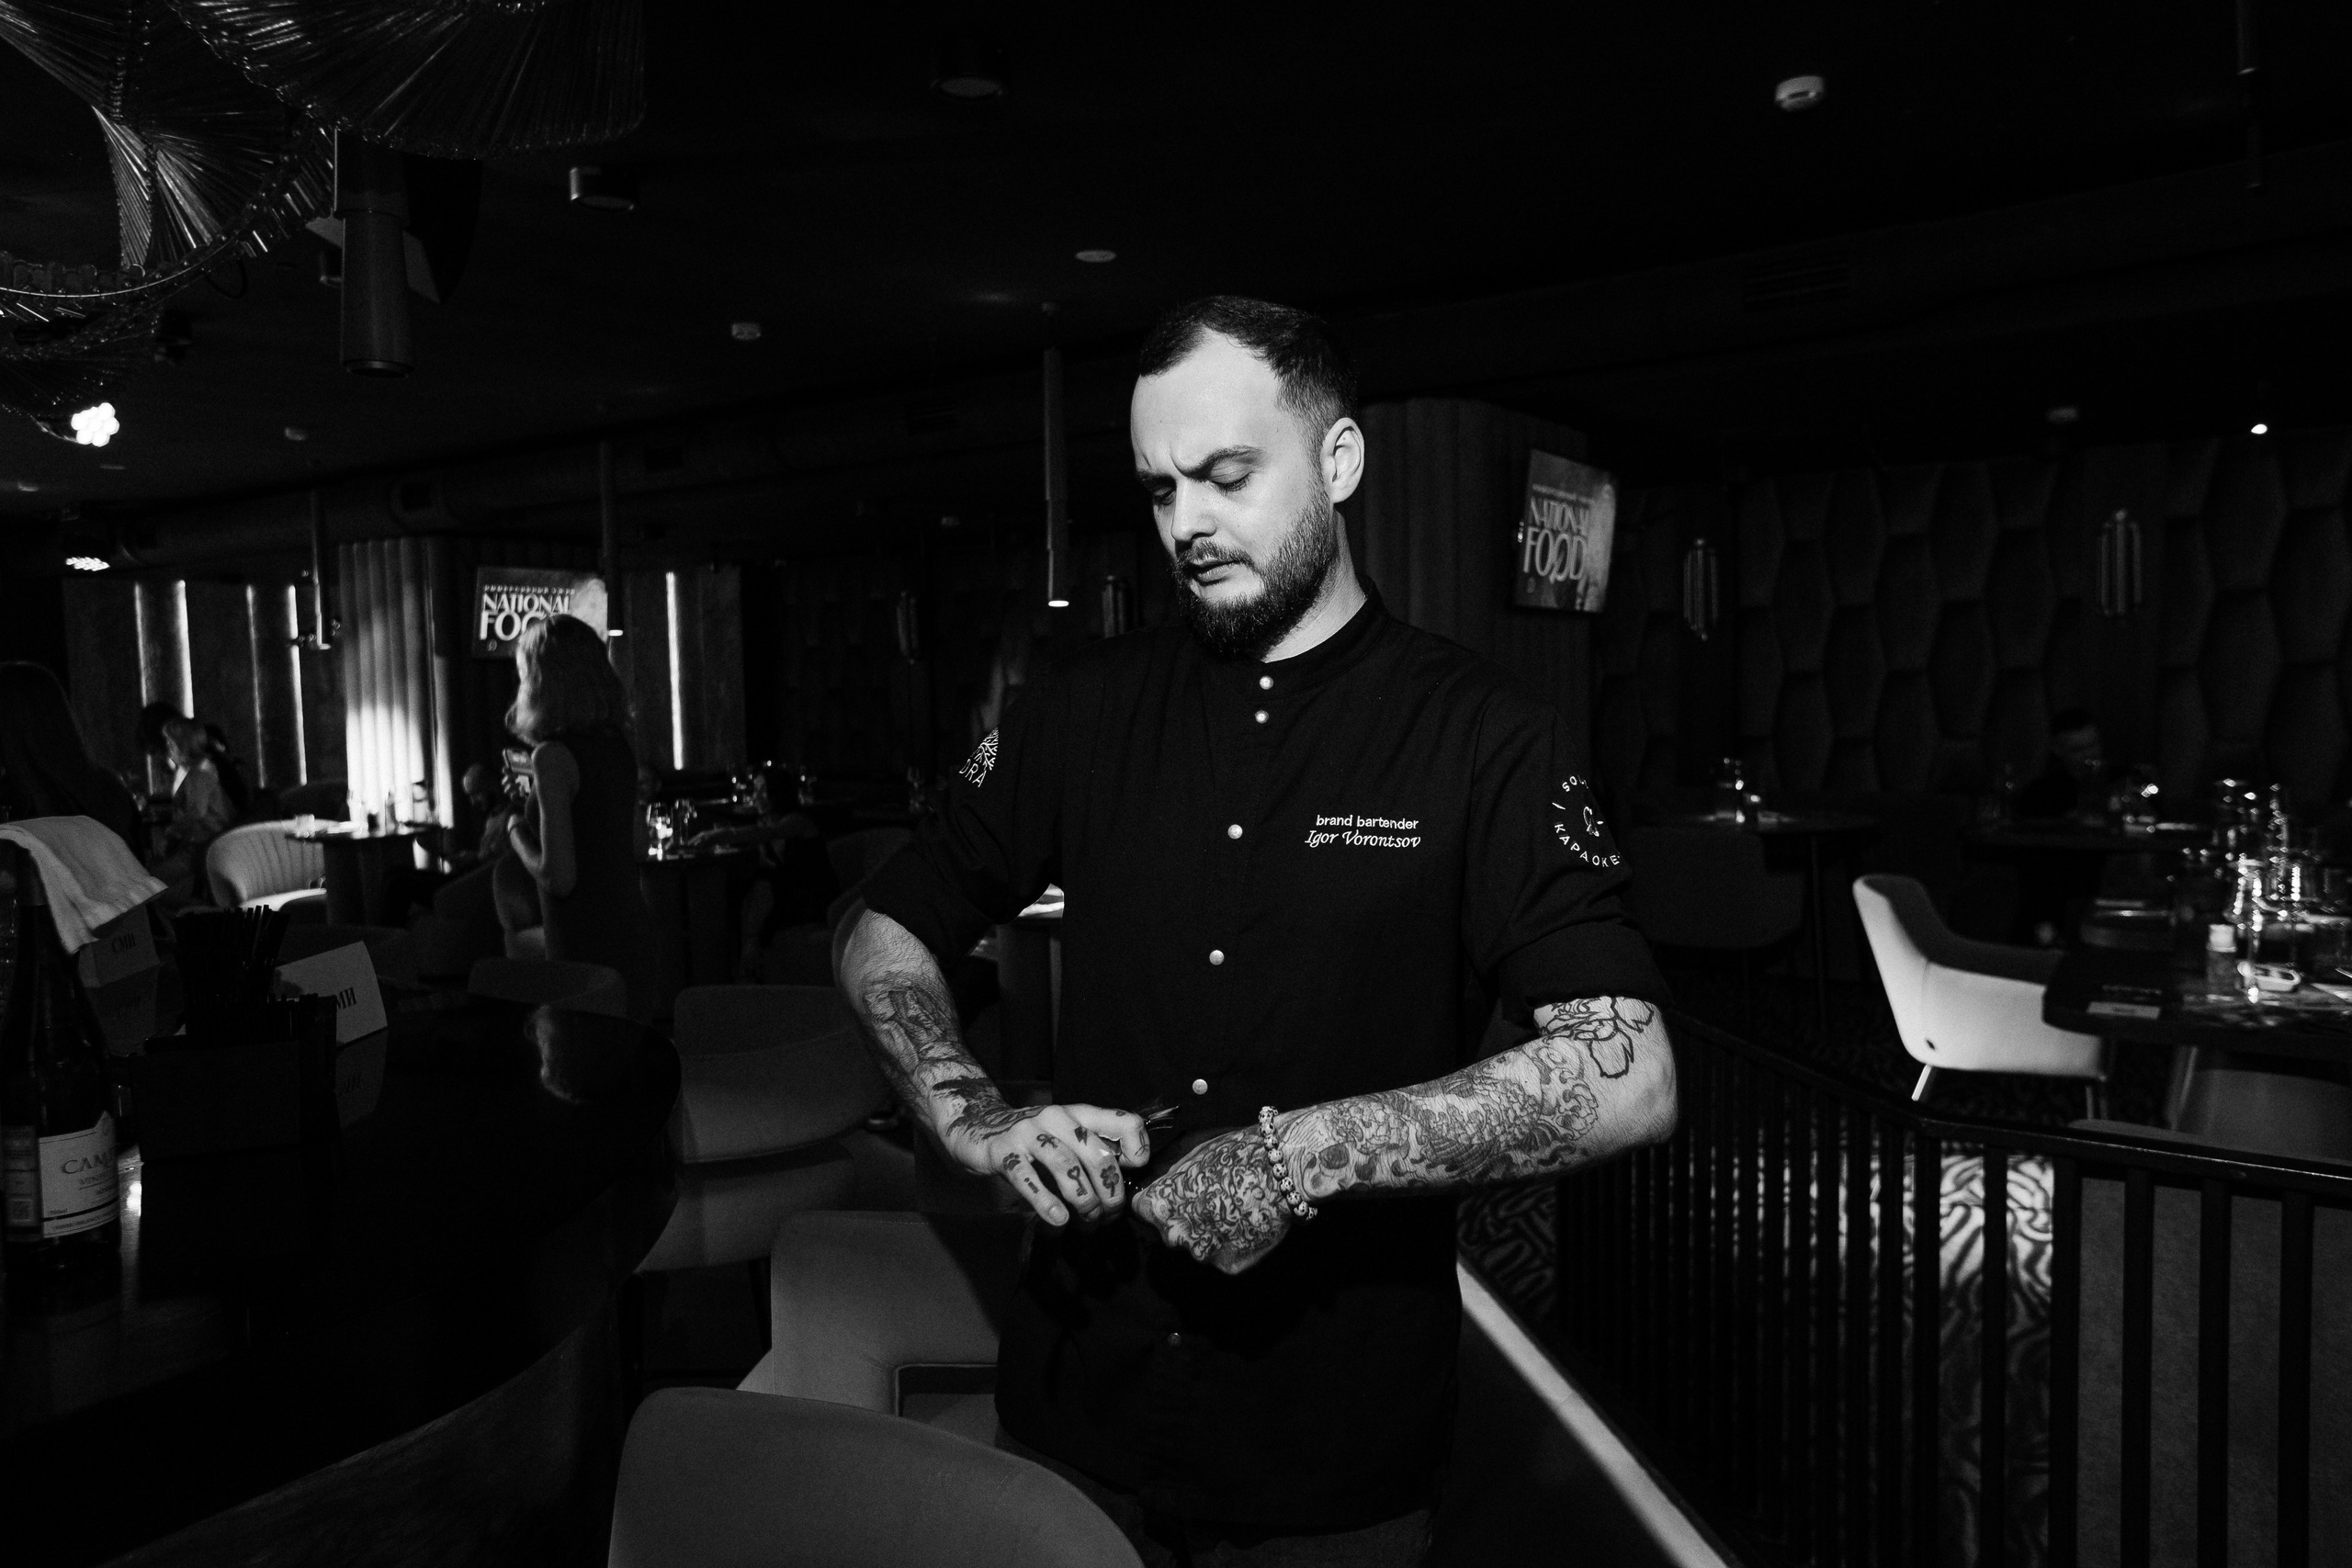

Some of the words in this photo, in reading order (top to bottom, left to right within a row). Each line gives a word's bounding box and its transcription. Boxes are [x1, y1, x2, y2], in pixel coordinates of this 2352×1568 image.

[1522, 526, 1587, 584] FOOD
[1316, 814, 1353, 827] brand
[1356, 815, 1419, 830] bartender
[1304, 829, 1340, 849] Igor
[1341, 829, 1421, 849] Vorontsov
